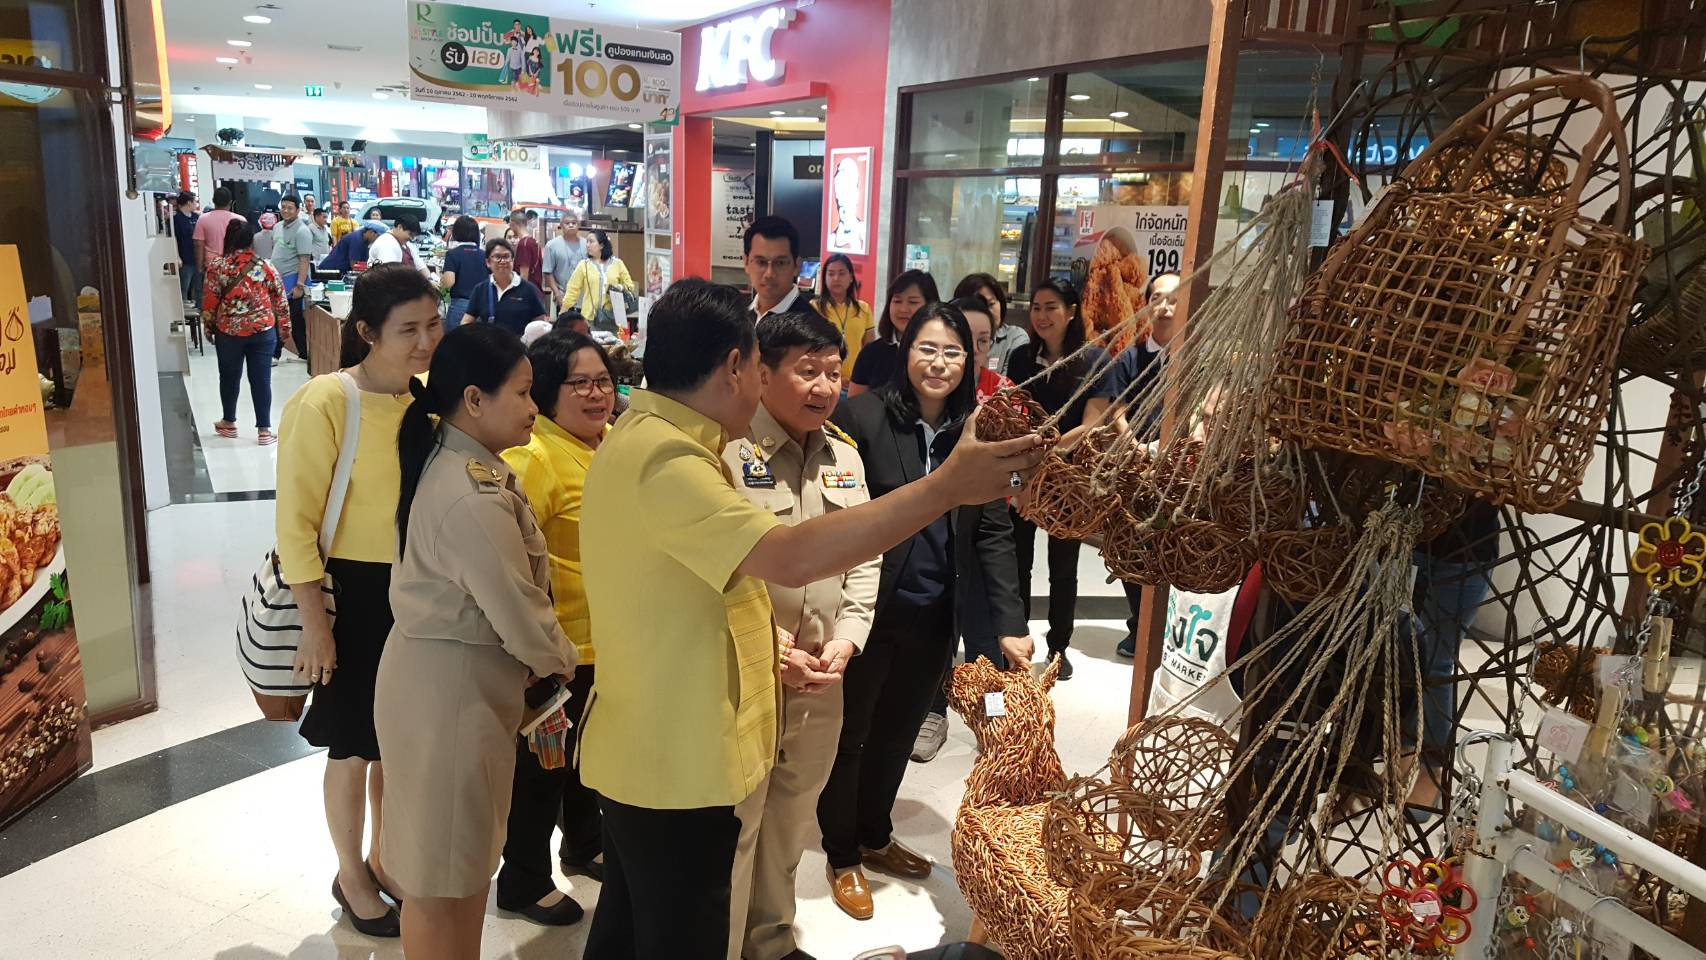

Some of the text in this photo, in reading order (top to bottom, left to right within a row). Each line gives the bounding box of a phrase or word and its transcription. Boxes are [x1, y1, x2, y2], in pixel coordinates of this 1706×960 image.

[445, 47, 500, 66] รับ เลย
[556, 28, 602, 57] ฟรี!
[695, 7, 787, 91] KFC
[557, 58, 641, 101] 100
[503, 148, 528, 162] 100
[1148, 249, 1179, 276] 199
